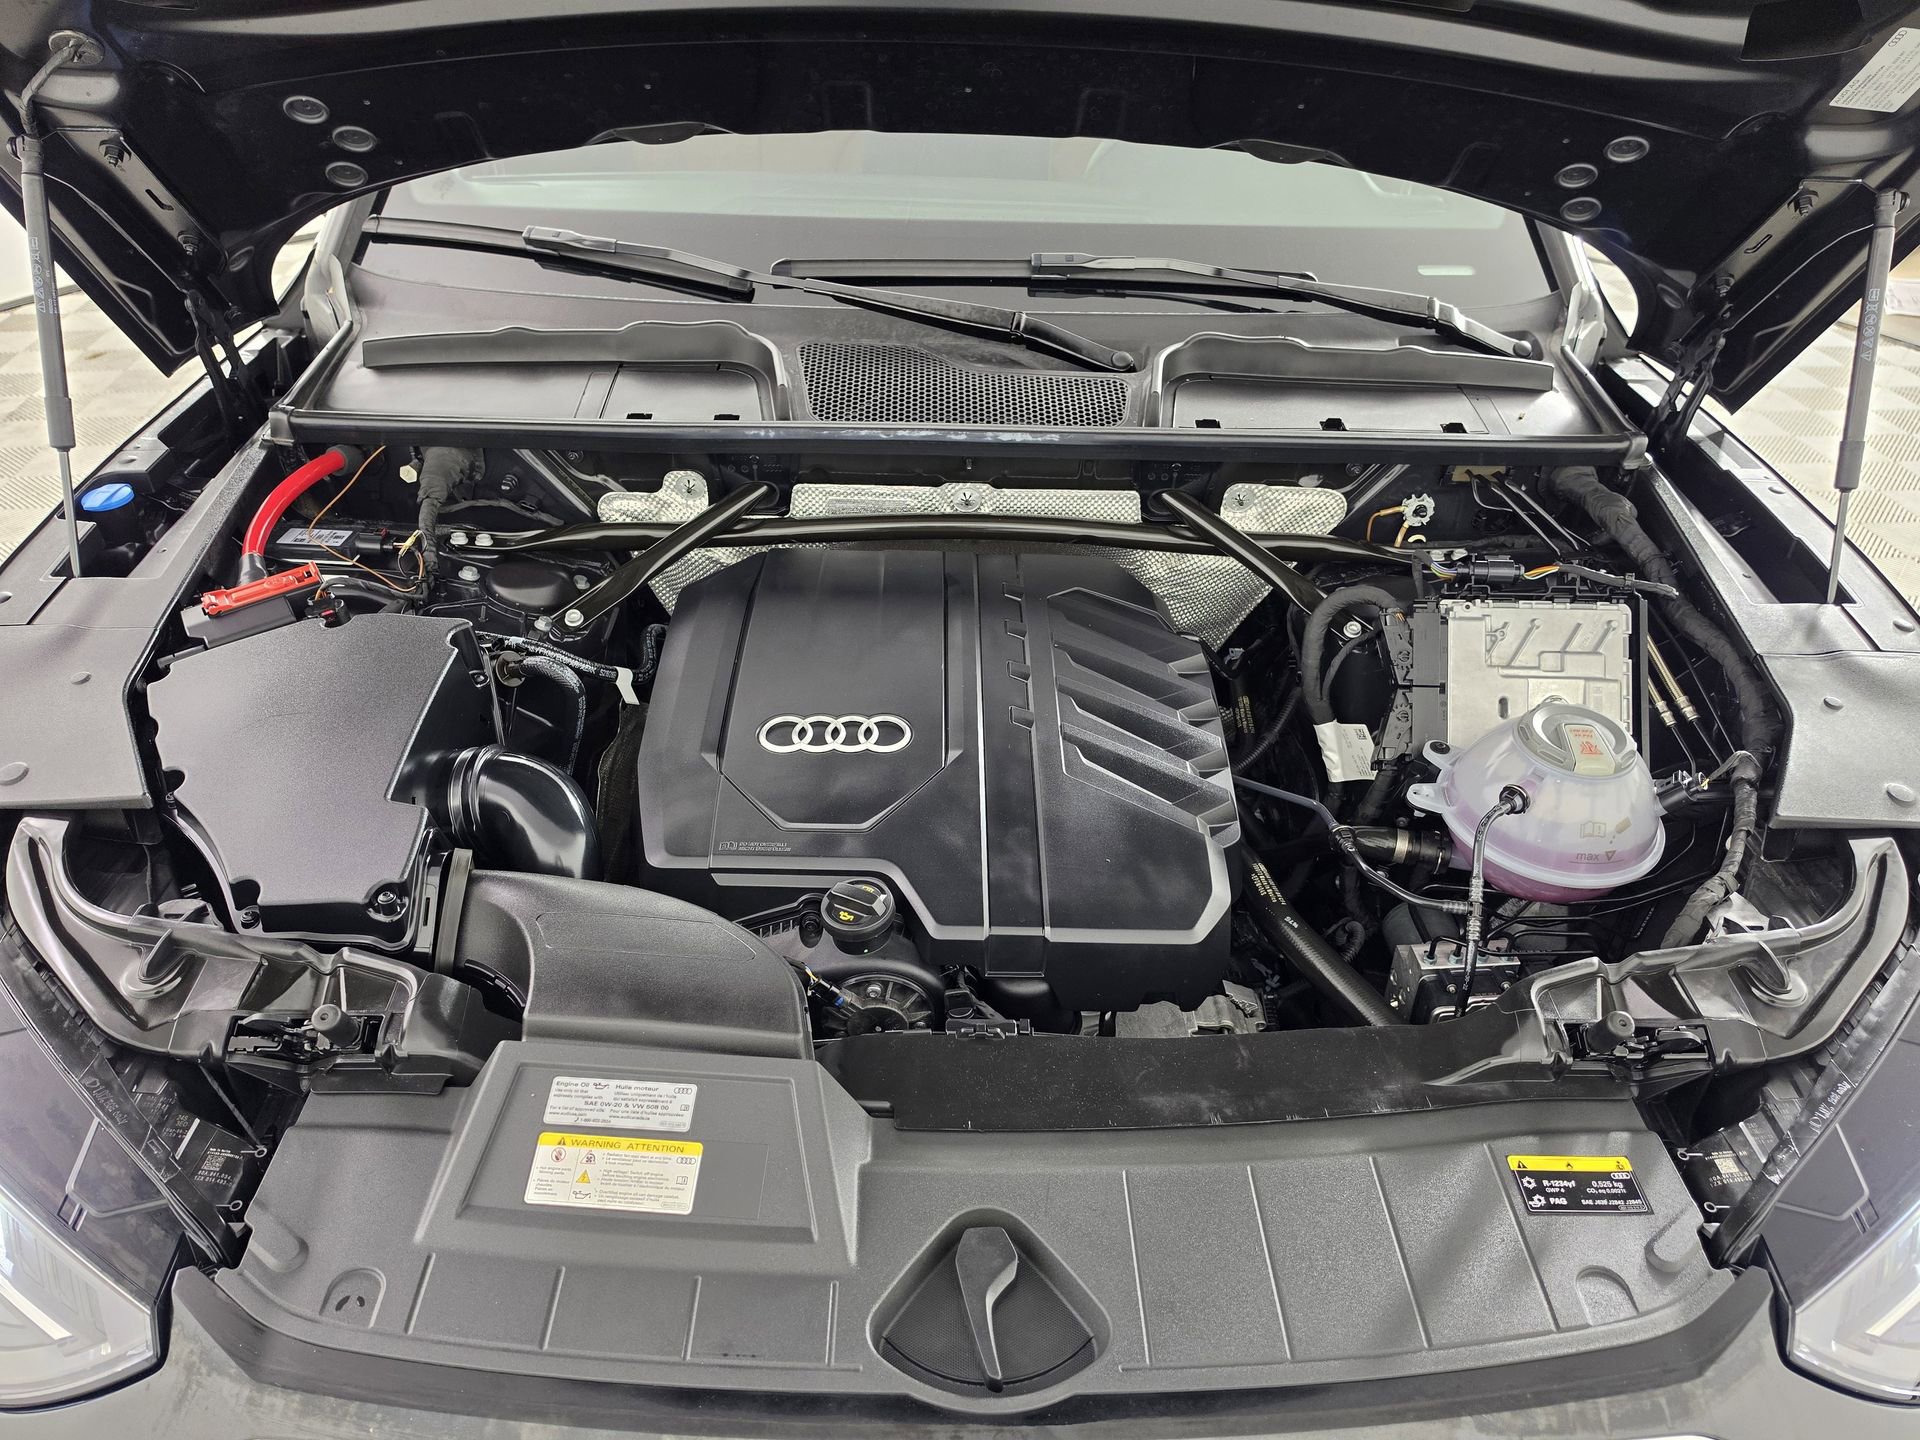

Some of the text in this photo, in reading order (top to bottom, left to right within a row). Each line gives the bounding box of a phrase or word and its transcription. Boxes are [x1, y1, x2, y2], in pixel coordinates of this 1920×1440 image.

[1576, 853, 1599, 861] max
[571, 1139, 685, 1153] WARNING ATTENTION
[1542, 1180, 1576, 1188] R-1234yf
[1592, 1180, 1612, 1188] 0,525
